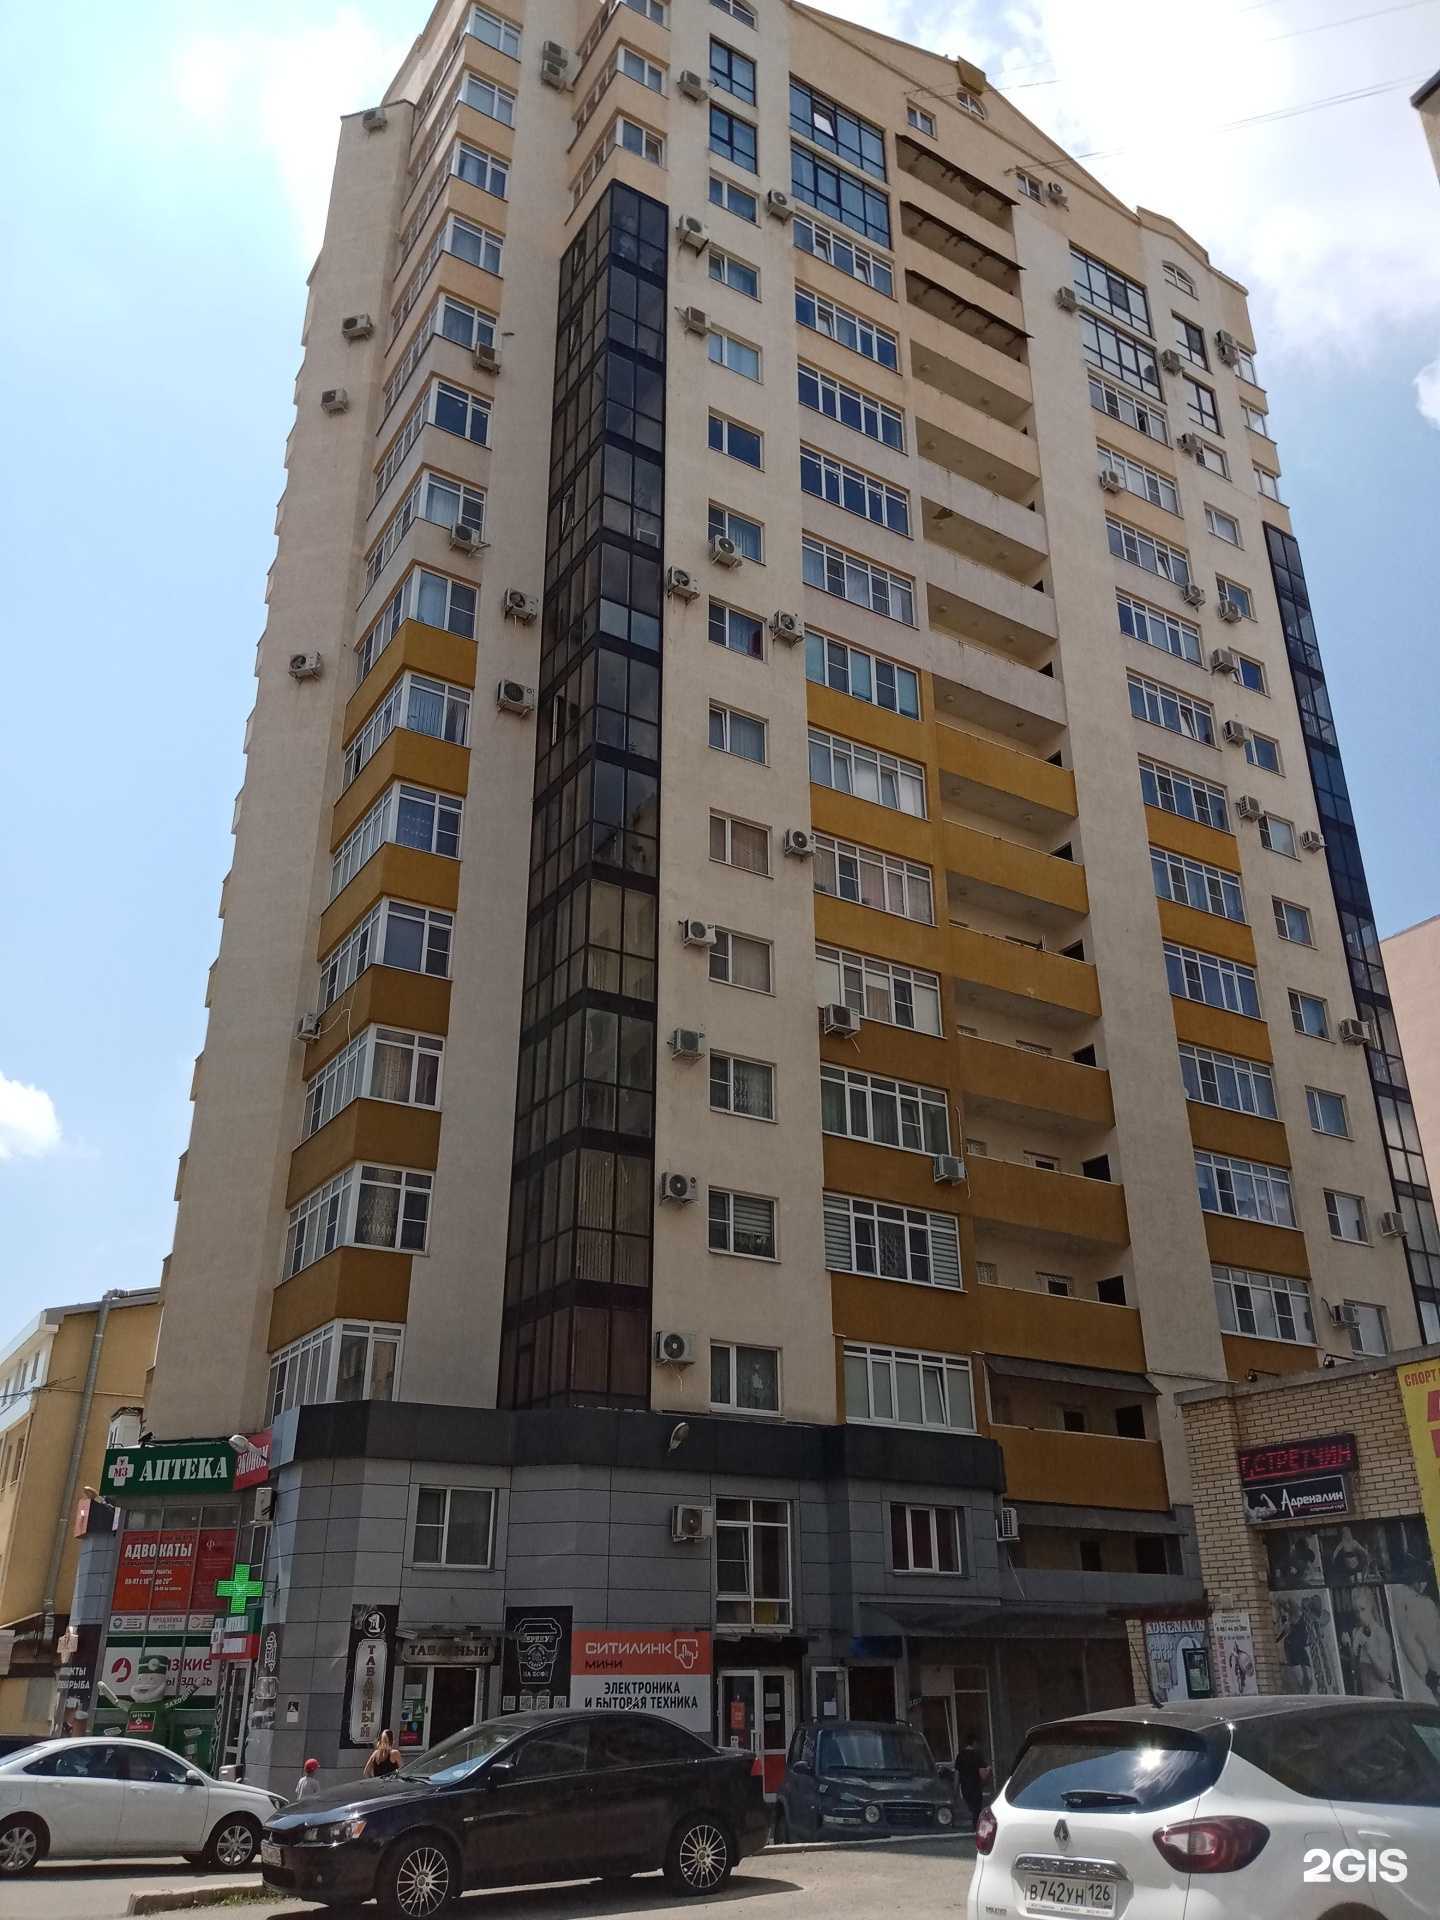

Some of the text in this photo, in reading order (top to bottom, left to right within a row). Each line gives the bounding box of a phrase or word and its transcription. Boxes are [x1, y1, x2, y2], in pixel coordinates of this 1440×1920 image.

[1404, 1371, 1437, 1387] СПОРТ
[139, 1456, 228, 1482] АПТЕКА
[1281, 1489, 1344, 1518] Адреналин
[125, 1543, 193, 1559] АДВОКАТЫ
[585, 1642, 672, 1655] СИТИЛИНК
[585, 1660, 623, 1670] МИНИ
[604, 1681, 681, 1695] ЭЛЕКТРОНИКА
[584, 1695, 698, 1711] И БЫТОВАЯ ТЕХНИКА
[1088, 1883, 1111, 1901] 126
